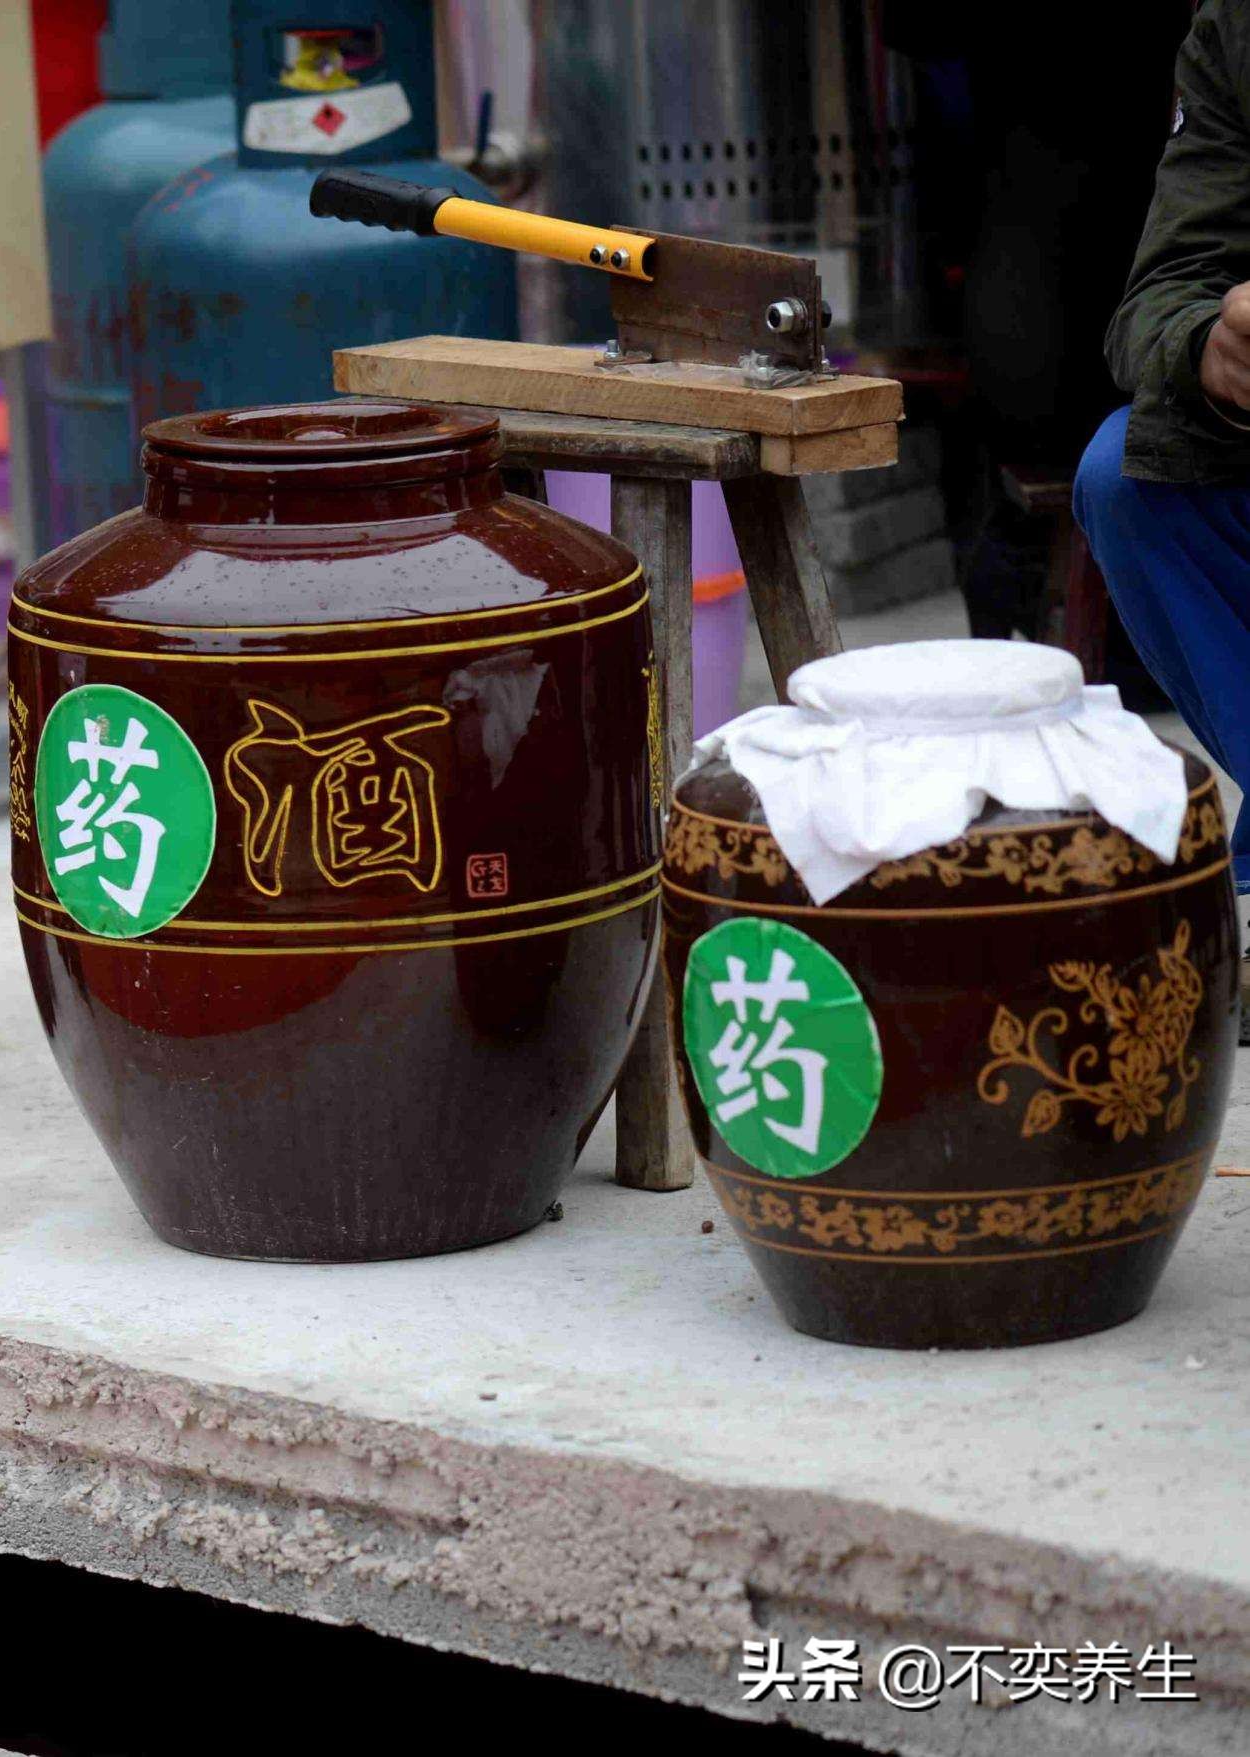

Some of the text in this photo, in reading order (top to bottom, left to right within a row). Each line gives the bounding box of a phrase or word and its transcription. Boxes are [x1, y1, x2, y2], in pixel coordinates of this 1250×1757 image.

[55, 717, 159, 918] 药
[223, 699, 451, 897] 酒
[708, 948, 829, 1156] 药
